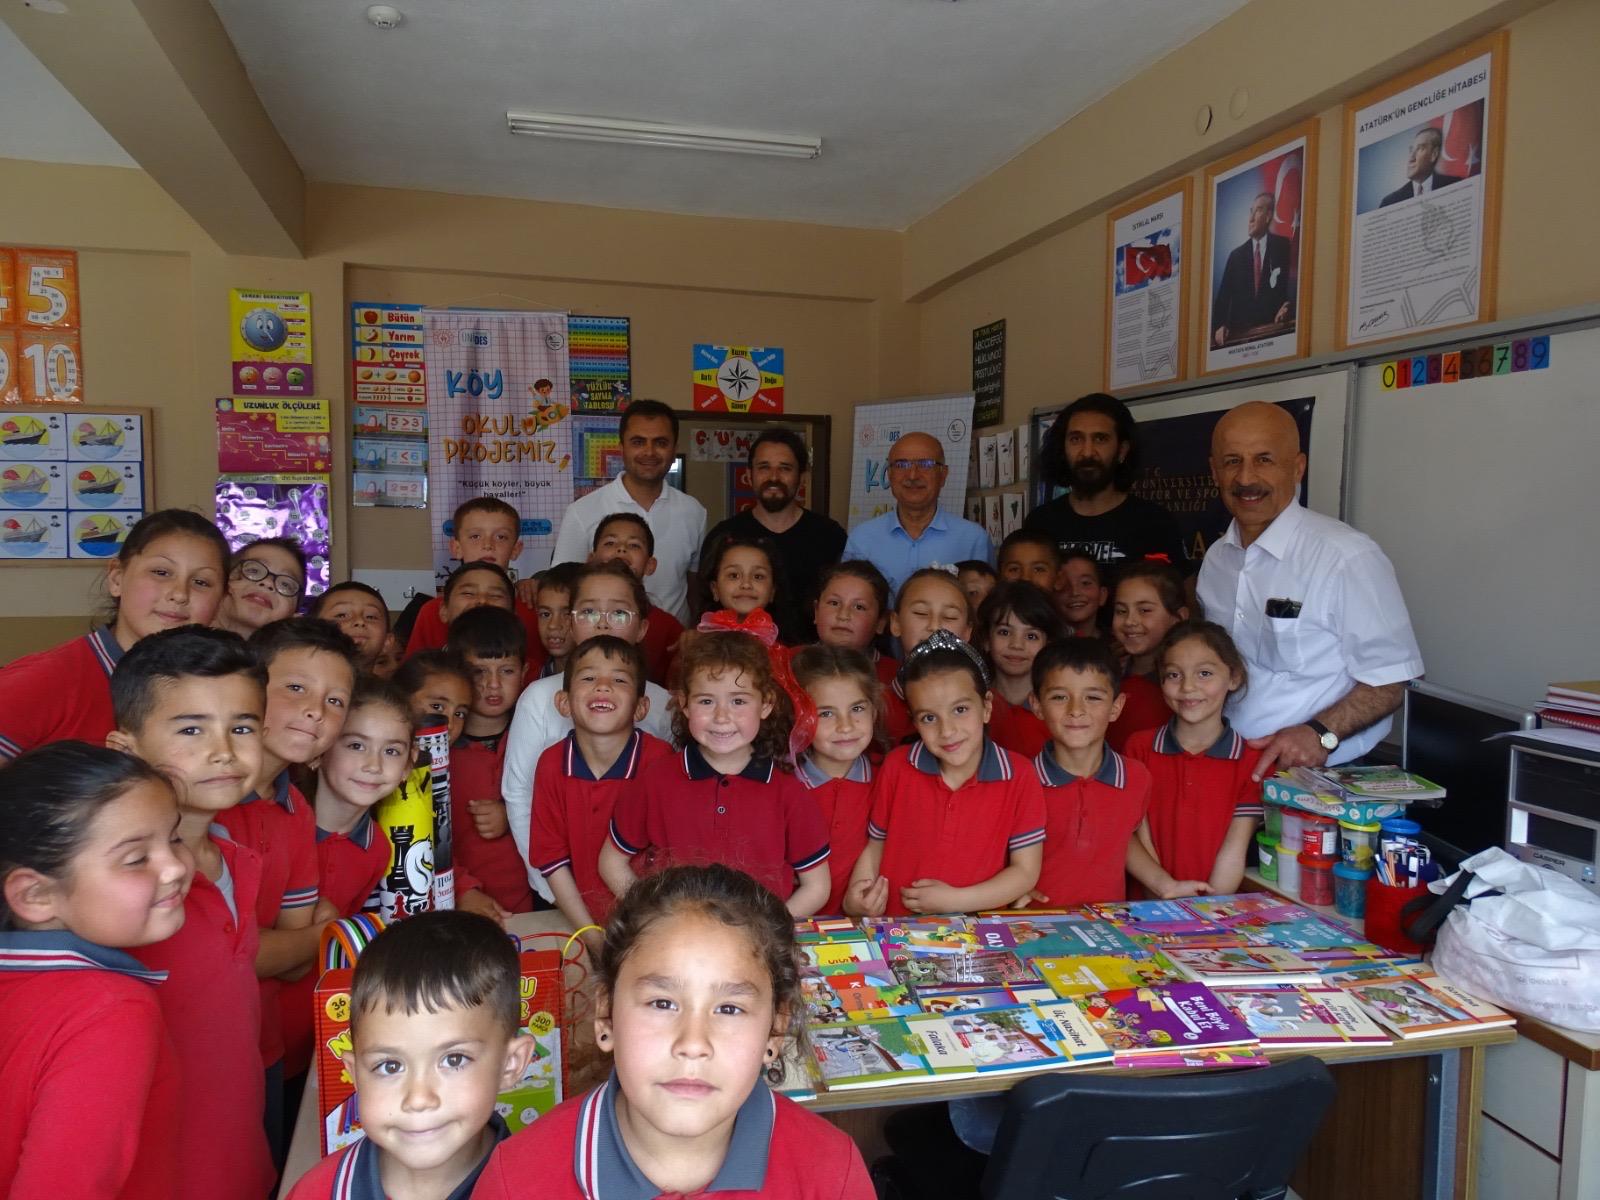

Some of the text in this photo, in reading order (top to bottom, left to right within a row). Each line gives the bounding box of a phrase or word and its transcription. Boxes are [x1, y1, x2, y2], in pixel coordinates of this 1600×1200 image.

[1359, 69, 1487, 134] ATATÜRK'ÜN GENÇLİĞE HİTABESİ
[387, 311, 415, 323] Bütün
[388, 331, 416, 342] Yarım
[388, 348, 420, 361] Çeyrek
[446, 368, 503, 399] KÖY
[243, 401, 279, 409] UZUNLUK
[283, 400, 320, 412] ÖLÇÜLERİ
[462, 412, 538, 437] OKULU
[443, 439, 556, 464] PROJEMİZ
[865, 457, 889, 493] KÖ
[524, 480, 552, 489] büyük
[1197, 487, 1219, 499] SPO
[331, 997, 346, 1011] 36
[335, 1010, 346, 1019] AY
[1177, 1000, 1213, 1030] Kabul Et
[1189, 995, 1230, 1031] Beni Böyle
[531, 1022, 549, 1032] PARÇA
[534, 1015, 551, 1027] 300
[1052, 1009, 1087, 1048] Üç Nasihat
[925, 1029, 948, 1056] Falaka
